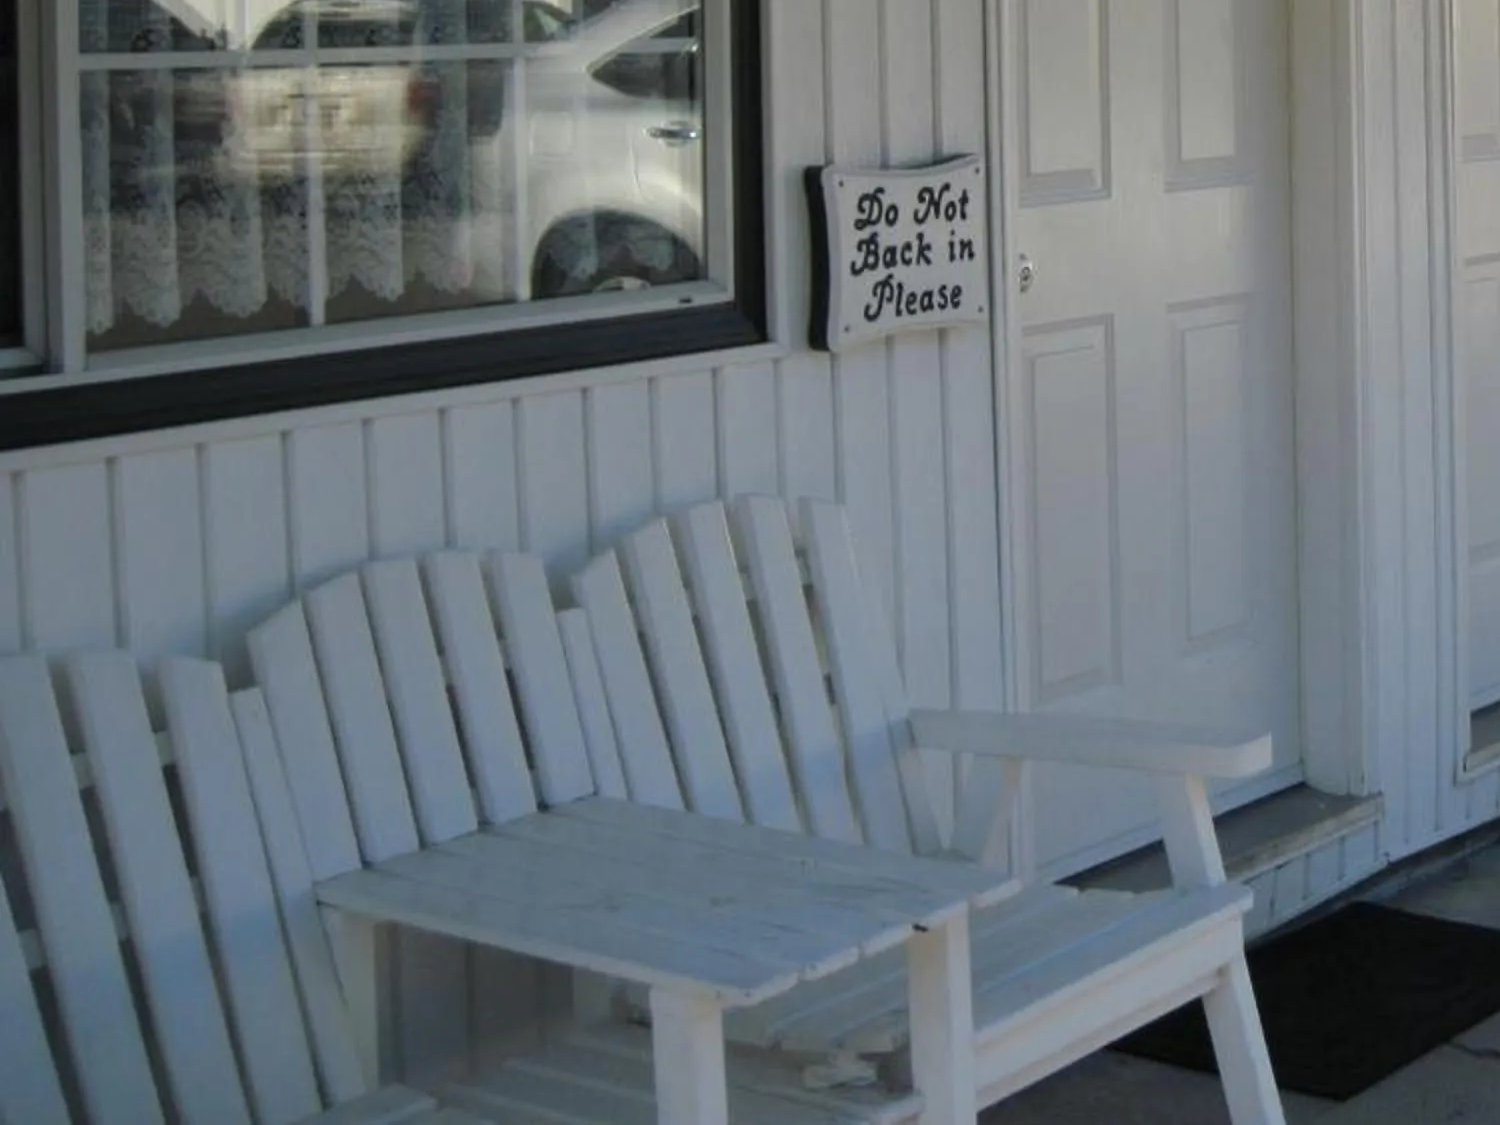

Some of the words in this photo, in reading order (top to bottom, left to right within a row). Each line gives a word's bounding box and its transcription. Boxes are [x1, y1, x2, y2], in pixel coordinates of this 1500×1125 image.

[854, 187, 899, 231] Do
[913, 182, 969, 225] Not
[851, 232, 932, 276] Back
[949, 230, 975, 262] in
[864, 274, 962, 322] Please
